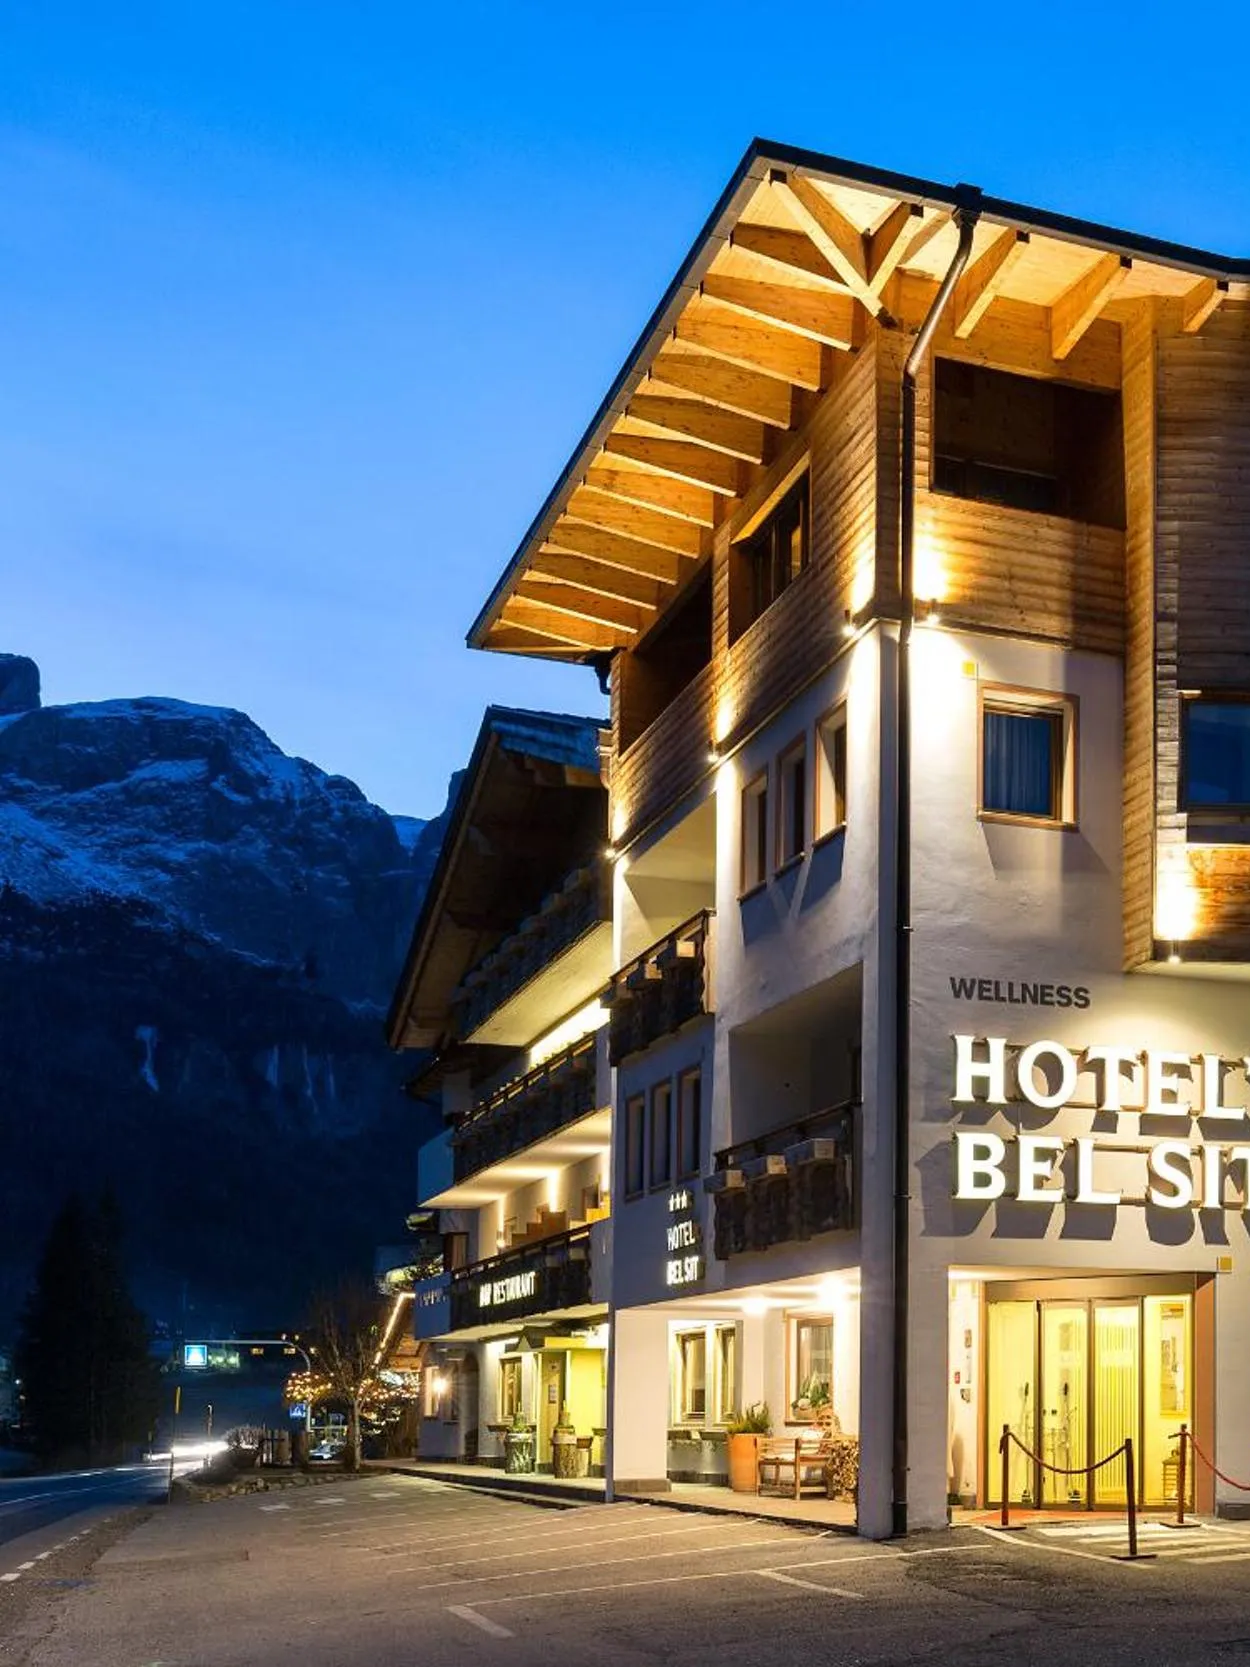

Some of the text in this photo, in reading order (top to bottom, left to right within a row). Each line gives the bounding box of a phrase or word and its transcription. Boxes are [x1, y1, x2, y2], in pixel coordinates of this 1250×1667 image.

[951, 977, 1090, 1008] WELLNESS
[952, 1034, 1248, 1119] HOTEL
[954, 1132, 1124, 1204] BEL
[667, 1220, 695, 1251] HOTEL
[667, 1255, 699, 1285] BEL SIT
[493, 1271, 536, 1305] RESTAURANT
